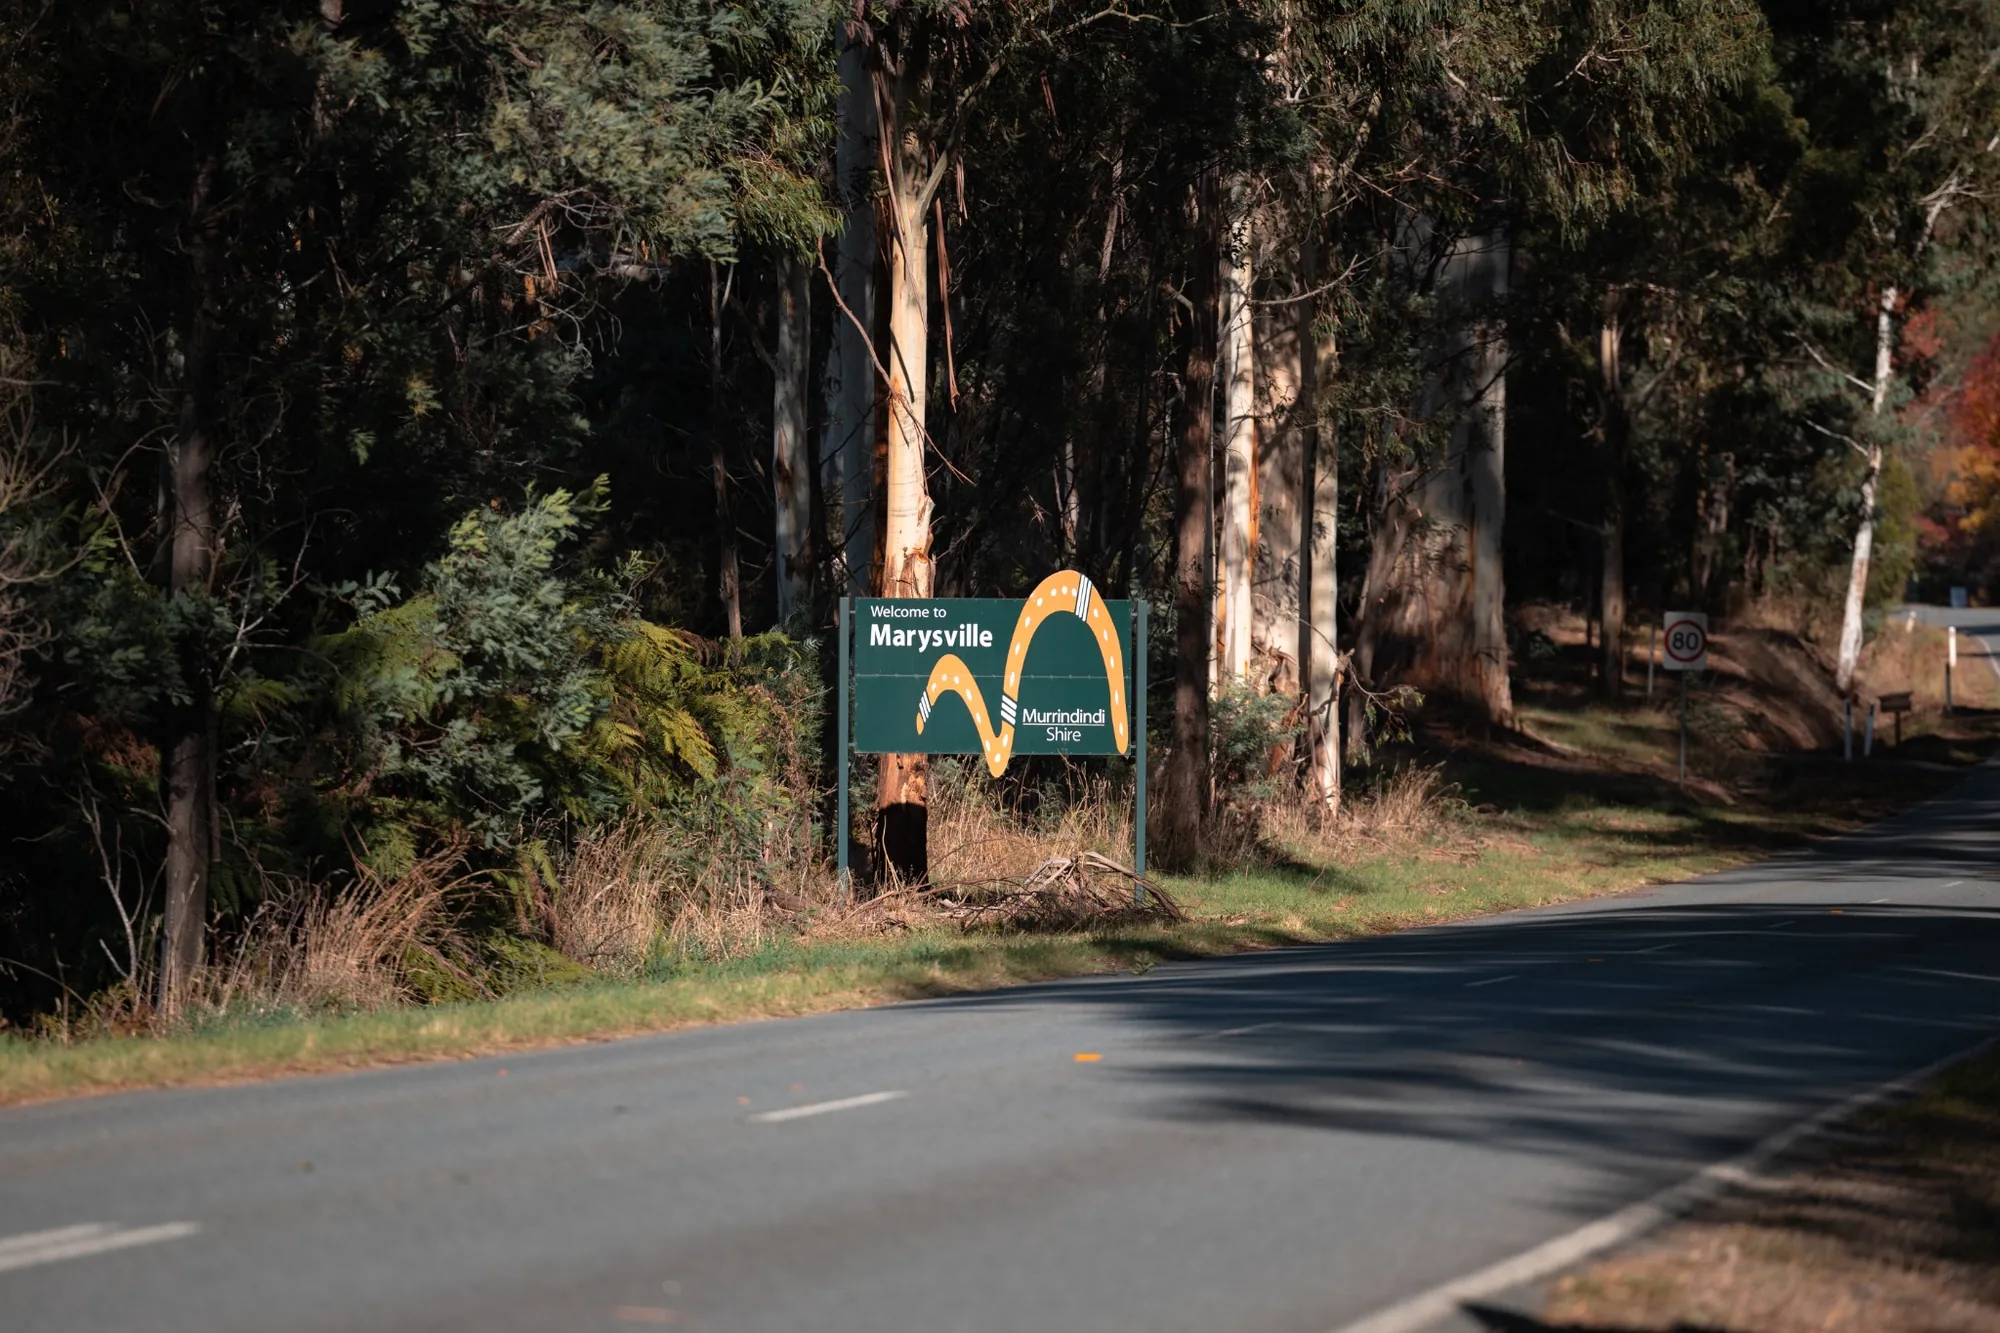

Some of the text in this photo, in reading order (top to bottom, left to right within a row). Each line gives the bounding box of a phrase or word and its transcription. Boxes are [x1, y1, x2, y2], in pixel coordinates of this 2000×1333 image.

[870, 605, 947, 618] Welcome to
[870, 623, 993, 653] Marysville
[1672, 631, 1699, 650] 80
[1022, 708, 1105, 724] Murrindindi
[1046, 726, 1082, 742] Shire
